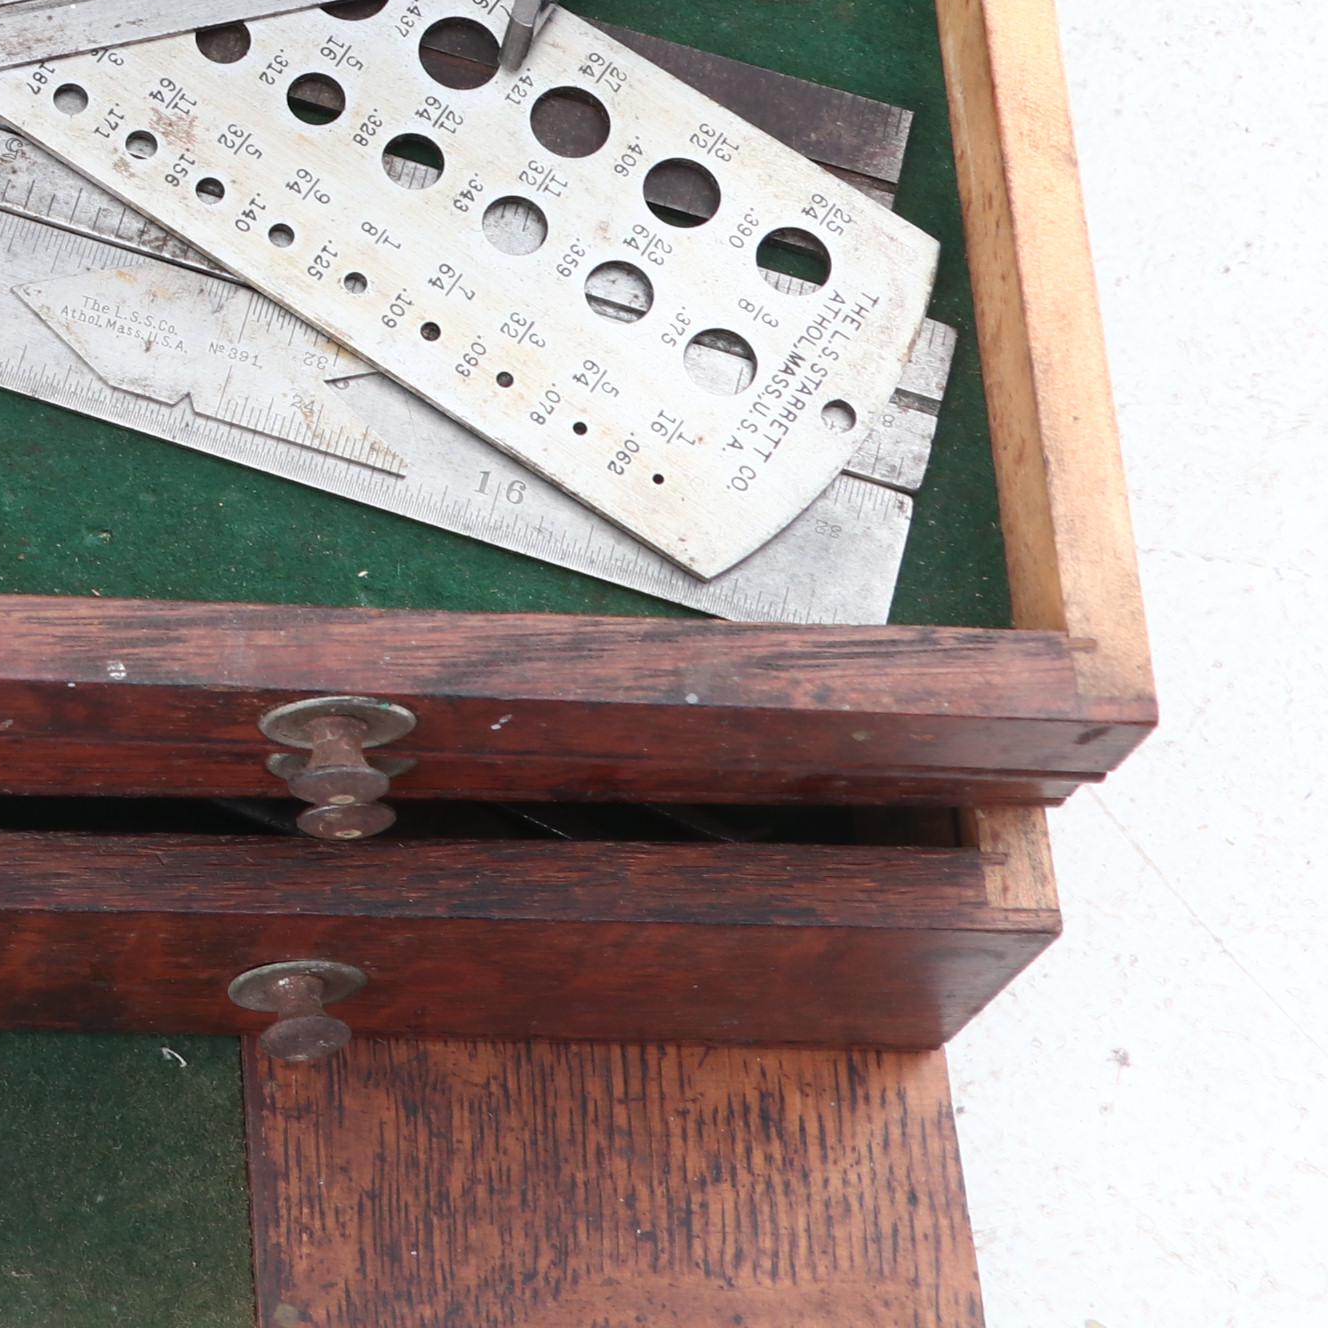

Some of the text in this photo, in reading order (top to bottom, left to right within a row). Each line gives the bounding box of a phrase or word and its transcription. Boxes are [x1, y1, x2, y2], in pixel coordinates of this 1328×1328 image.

[259, 49, 289, 85] .312
[504, 68, 534, 106] .421
[94, 103, 125, 139] .171
[353, 108, 383, 147] .328
[165, 148, 195, 187] .156
[614, 136, 643, 177] .406
[235, 193, 266, 232] .140
[453, 172, 484, 213] .343
[729, 207, 759, 249] .390
[307, 240, 338, 281] .125
[556, 238, 586, 277] .359
[381, 288, 413, 328] .109
[661, 306, 691, 348] .375
[843, 291, 880, 332] THE
[455, 335, 487, 378] .093
[530, 383, 561, 426] .078
[607, 431, 640, 476] .062
[474, 470, 527, 505] 16
[726, 465, 757, 492] CO.
